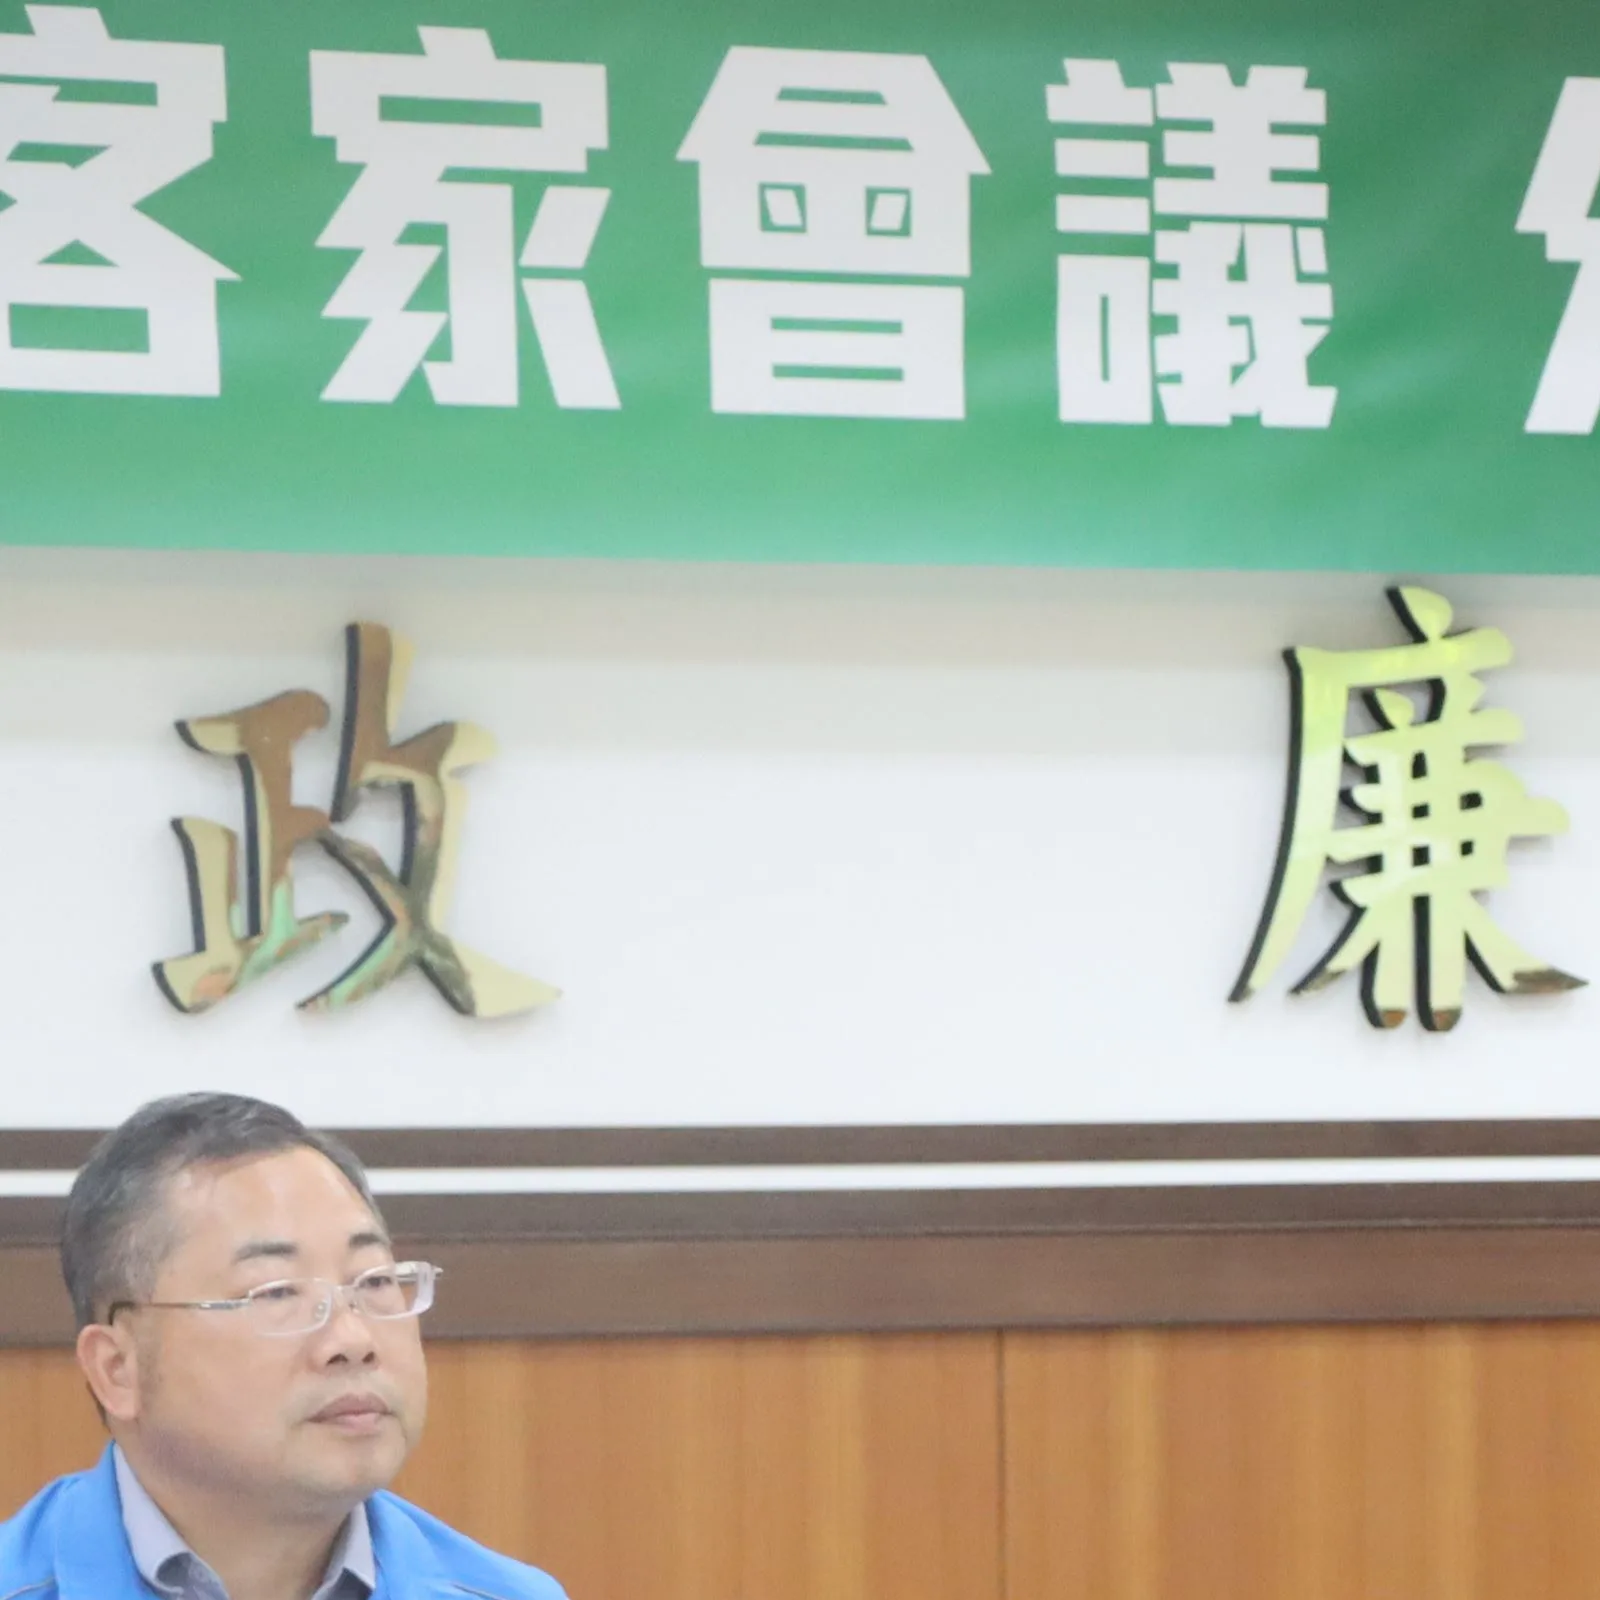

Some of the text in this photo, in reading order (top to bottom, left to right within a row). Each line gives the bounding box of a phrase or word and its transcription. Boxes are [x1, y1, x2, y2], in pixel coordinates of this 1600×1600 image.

[0, 4, 1338, 428] 客家會議
[148, 584, 1591, 1034] 政 廉
